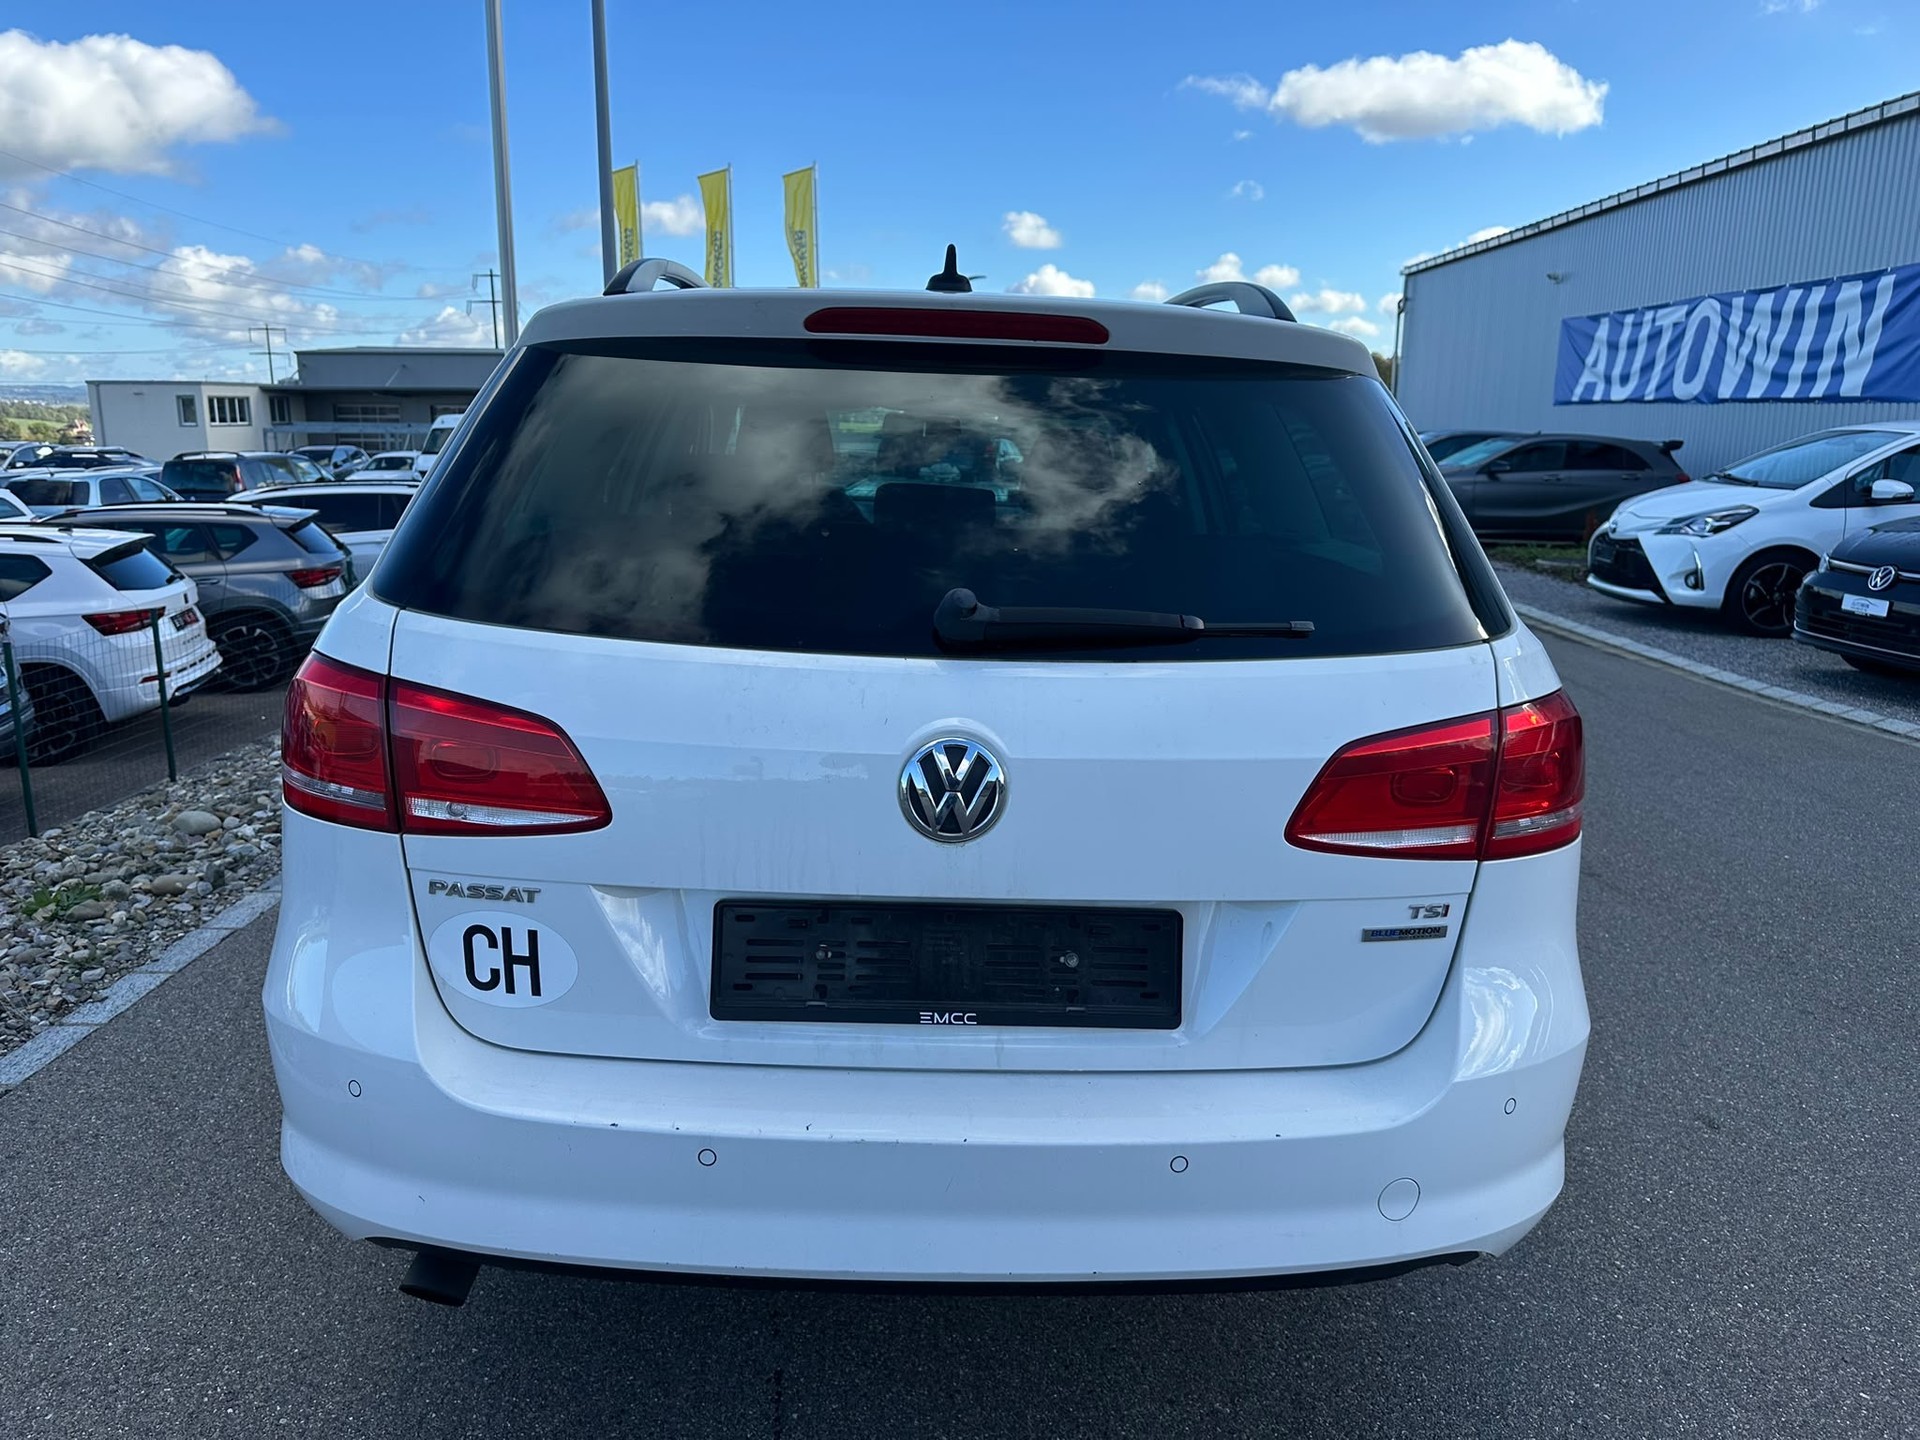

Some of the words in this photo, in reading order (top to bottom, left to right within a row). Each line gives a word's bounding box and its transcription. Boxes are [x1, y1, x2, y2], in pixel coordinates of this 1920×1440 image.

[1571, 274, 1896, 402] AUTOWIN
[1868, 566, 1895, 591] VW
[899, 737, 1005, 843] VW
[428, 879, 541, 903] PASSAT
[1408, 904, 1450, 920] TSI
[1370, 927, 1441, 938] BLUEMOTION
[462, 924, 542, 997] CH
[919, 1012, 977, 1025] EMCC
